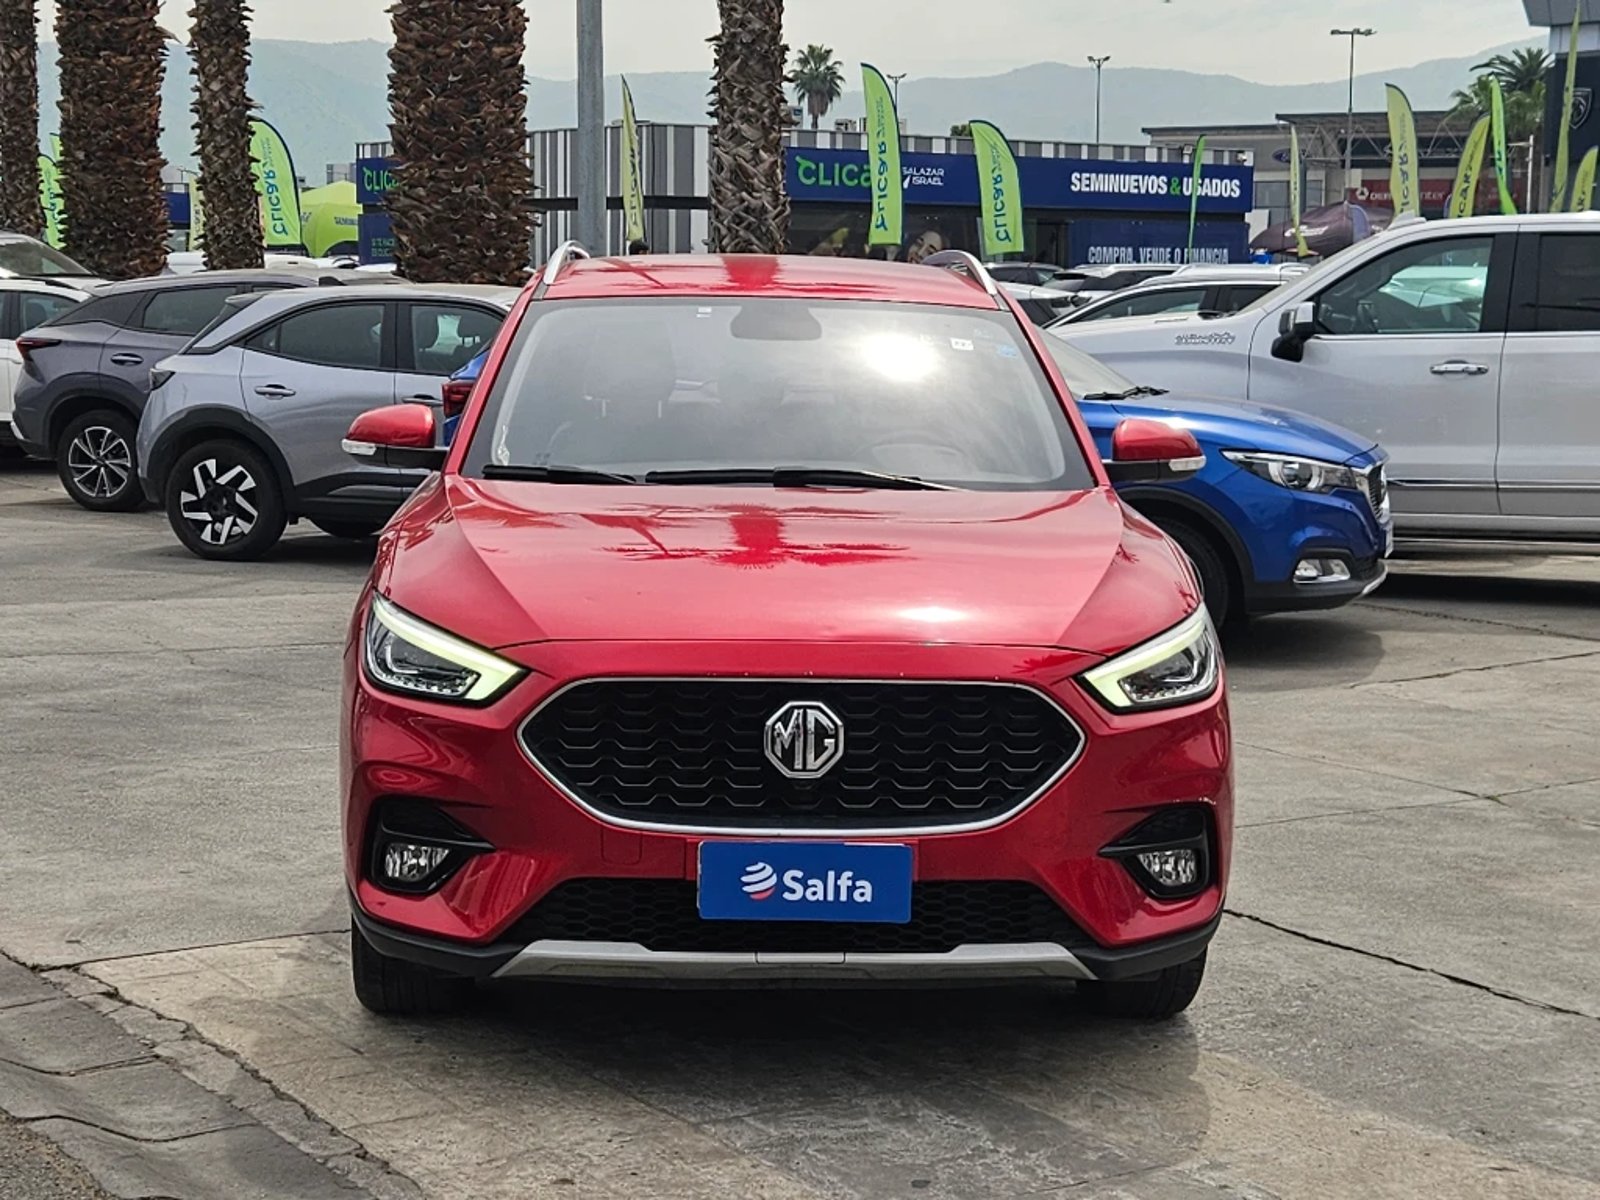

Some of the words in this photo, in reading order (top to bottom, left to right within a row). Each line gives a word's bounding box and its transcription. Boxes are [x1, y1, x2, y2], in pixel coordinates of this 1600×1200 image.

[362, 166, 399, 191] CLIC
[795, 155, 871, 188] CLICa
[902, 167, 944, 176] SALAZAR
[912, 176, 944, 186] ISRAEL
[1071, 172, 1168, 194] SEMINUEVOS
[1170, 177, 1181, 195] &
[1139, 247, 1171, 264] VENDE
[1174, 247, 1181, 264] O
[1184, 247, 1229, 264] FNANCIA
[774, 708, 836, 770] MG
[782, 869, 872, 902] Salfa
